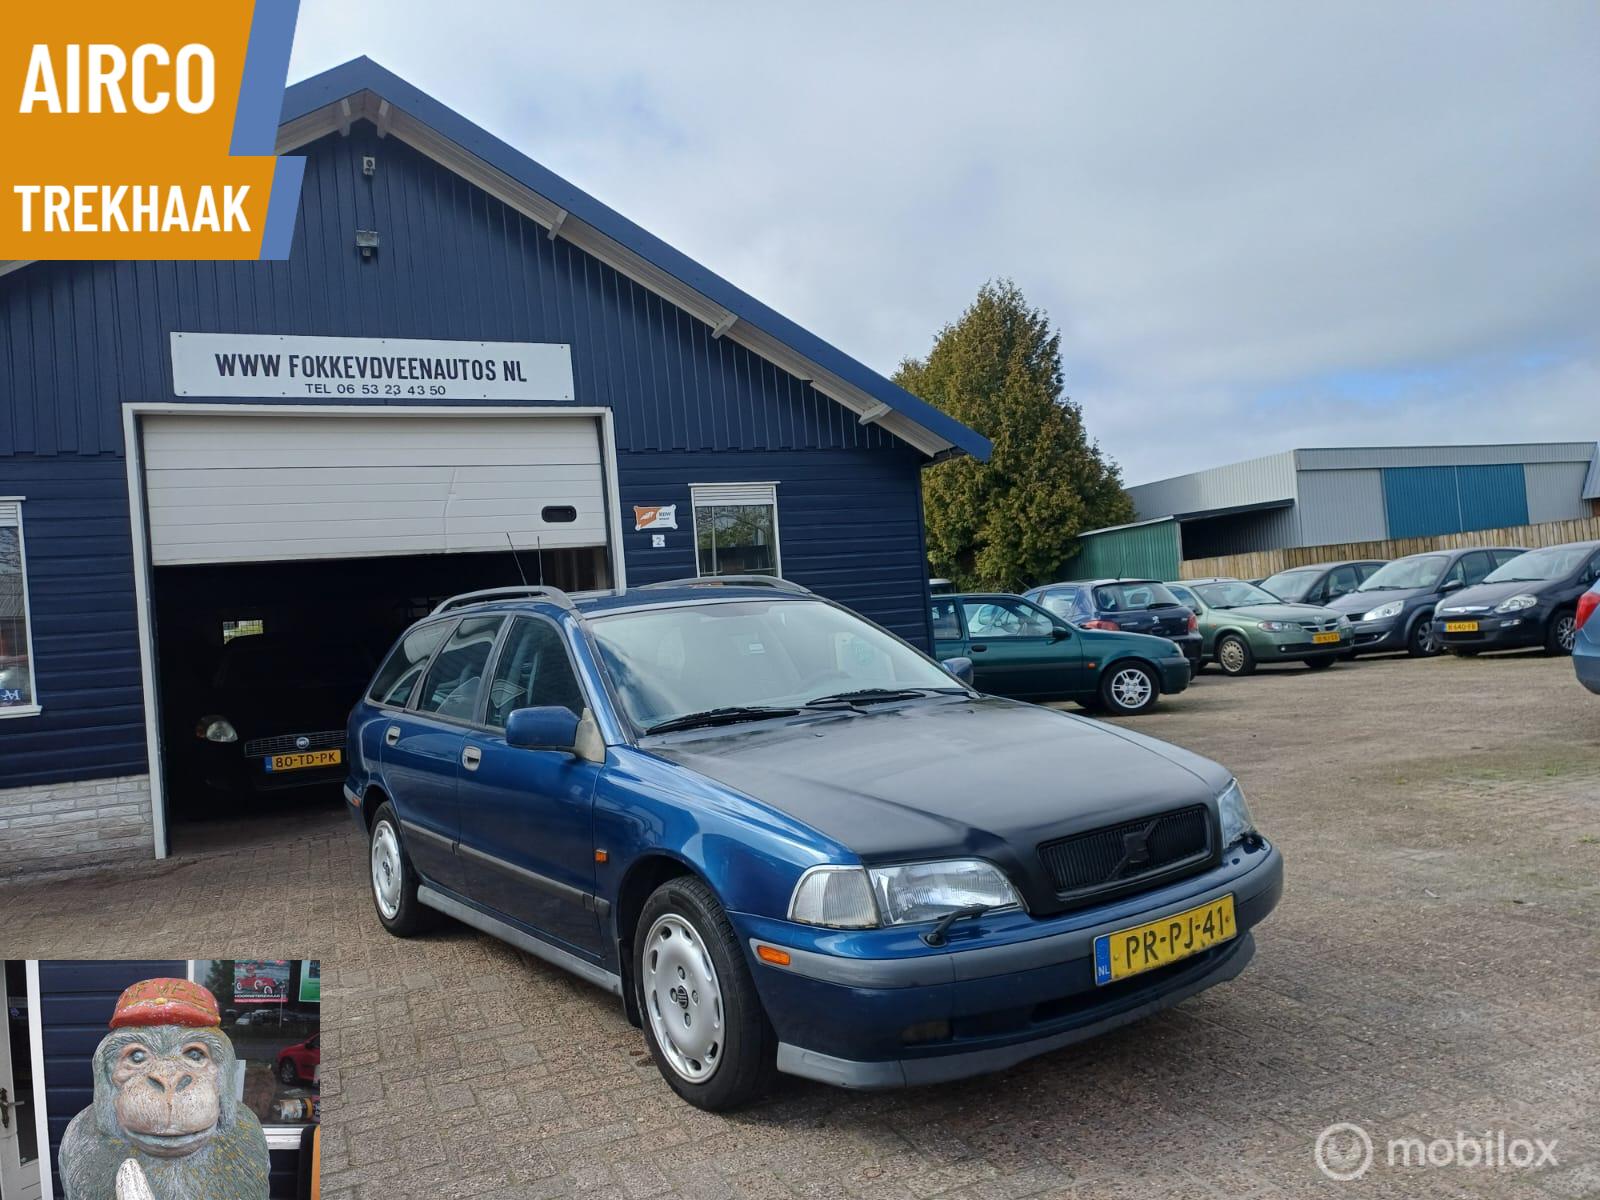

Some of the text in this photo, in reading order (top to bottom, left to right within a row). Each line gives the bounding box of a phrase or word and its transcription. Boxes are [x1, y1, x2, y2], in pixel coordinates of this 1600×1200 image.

[215, 353, 527, 382] WWW FOKKEVDVEENAUTOS NL
[305, 383, 446, 396] TEL 06 53 23 43 50
[275, 751, 337, 769] 80-TD-PK
[1125, 906, 1224, 970] PR-PJ-41
[1097, 965, 1110, 977] NL
